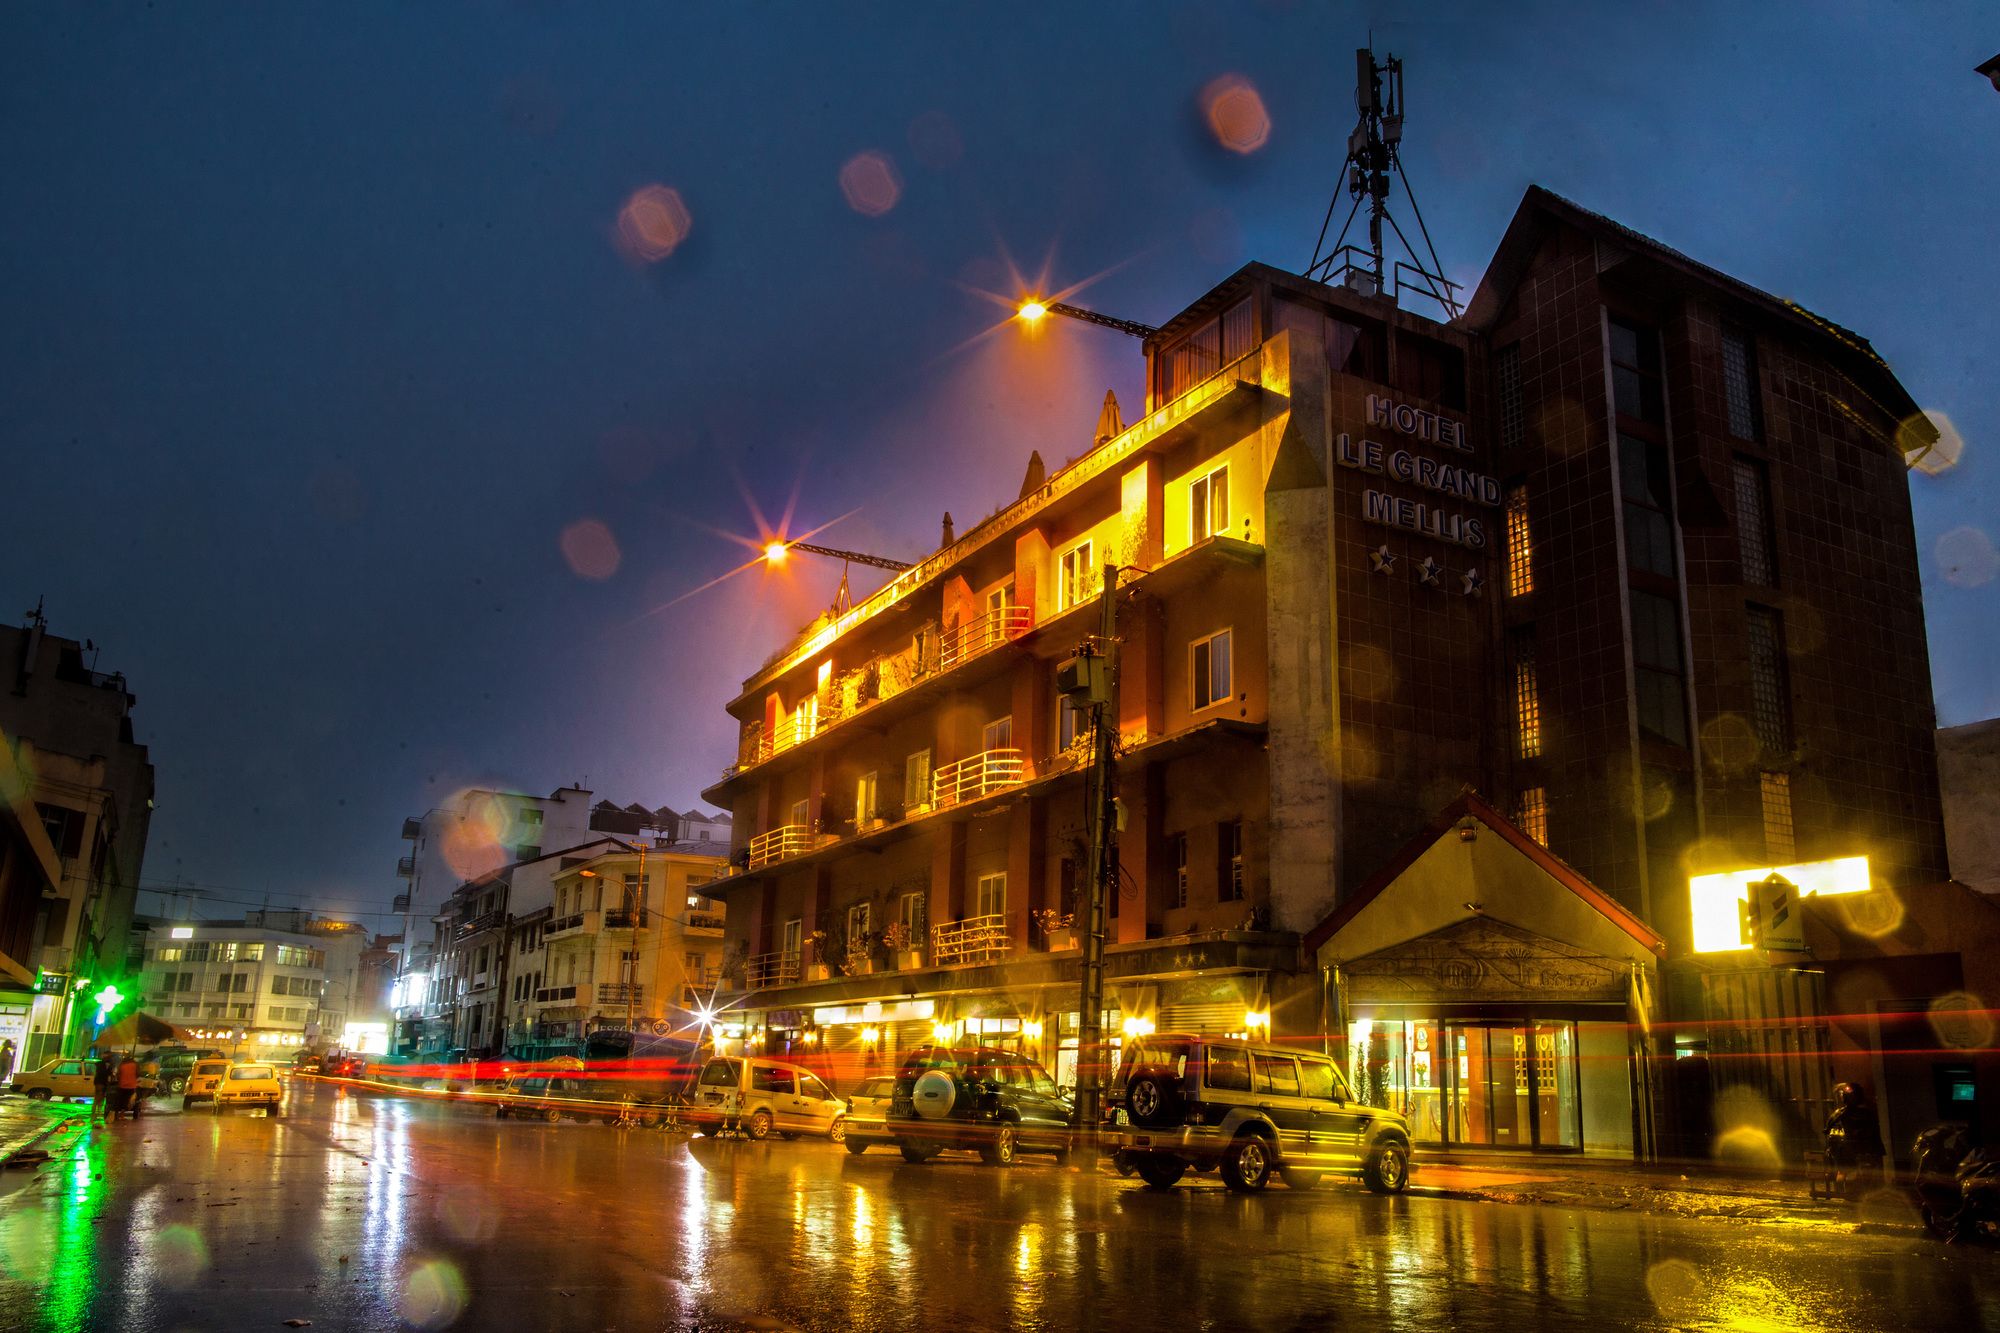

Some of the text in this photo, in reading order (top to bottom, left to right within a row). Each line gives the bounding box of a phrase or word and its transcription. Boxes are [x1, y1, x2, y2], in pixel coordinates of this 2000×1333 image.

[1366, 393, 1474, 454] HOTEL
[1336, 432, 1501, 508] LE GRAND
[1362, 489, 1485, 549] MELLIS
